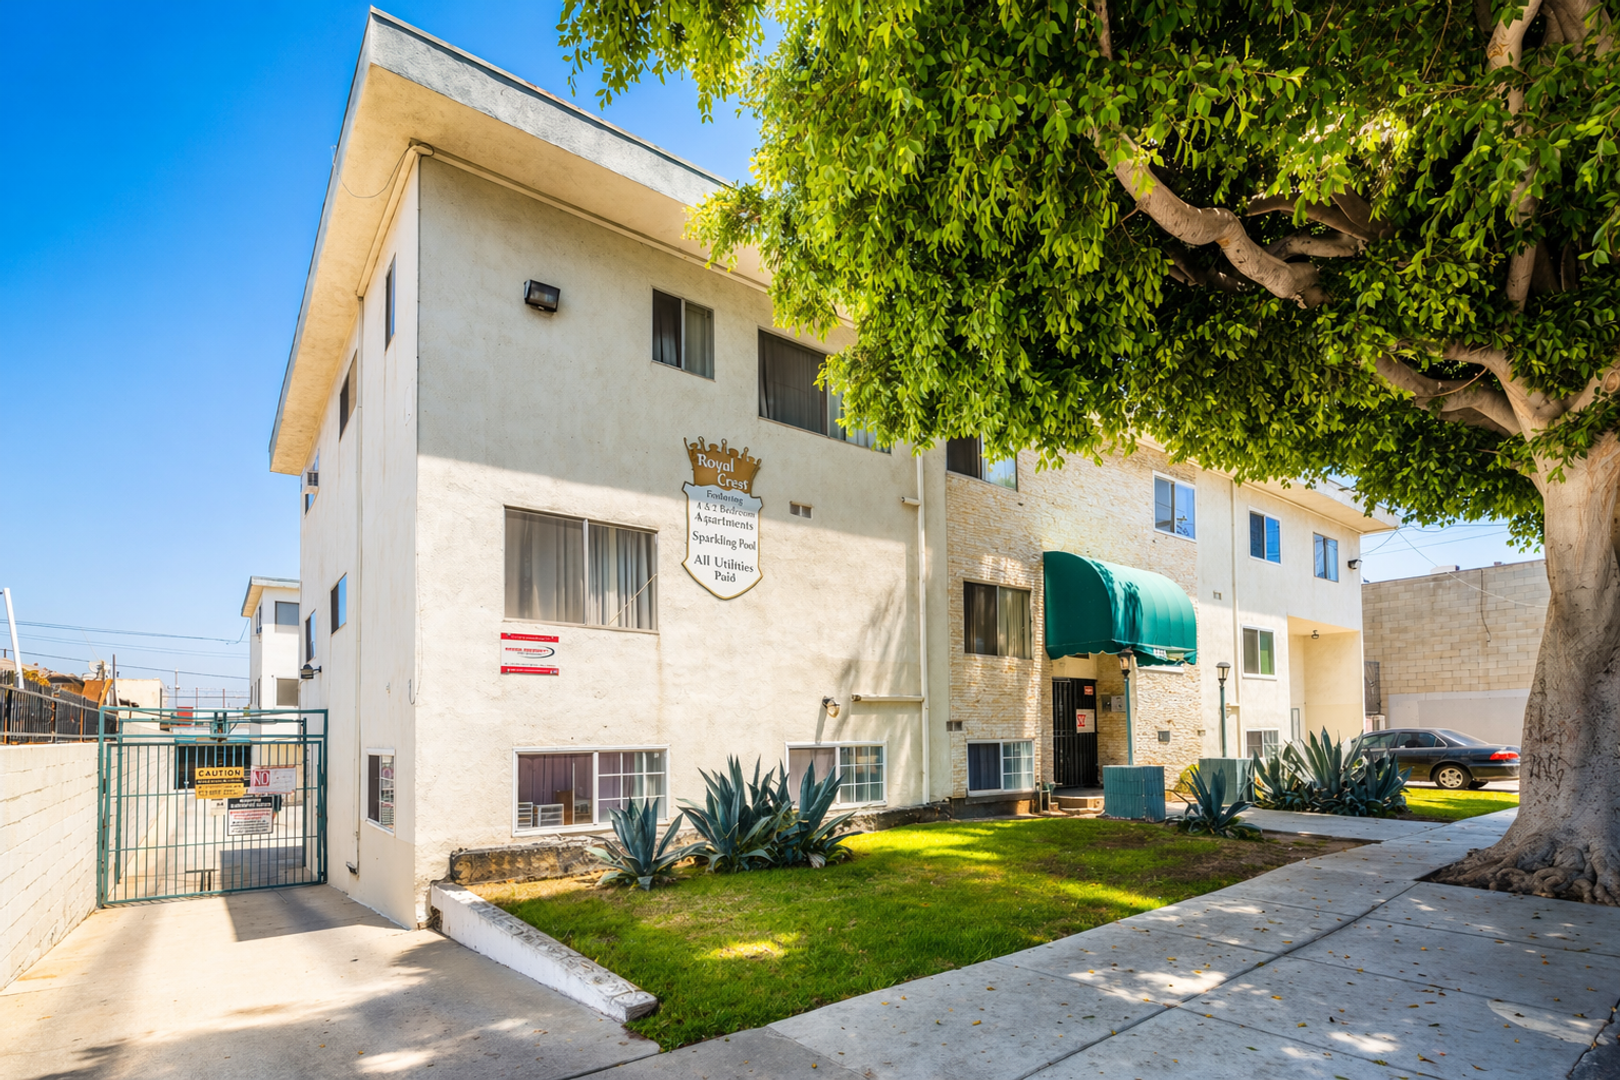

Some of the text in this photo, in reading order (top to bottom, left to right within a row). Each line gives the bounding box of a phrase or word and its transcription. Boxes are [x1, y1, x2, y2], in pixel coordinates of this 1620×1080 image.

[697, 453, 734, 473] Royal
[717, 473, 748, 490] Crest
[704, 502, 710, 511] &
[712, 504, 718, 512] 2
[720, 504, 755, 518] Bedroom
[694, 512, 754, 530] Apartments
[692, 530, 756, 550] Sparkling Pool
[694, 554, 754, 572] All Utilities
[714, 571, 736, 582] Paid
[198, 769, 241, 777] CAUTION
[253, 770, 269, 786] NO
